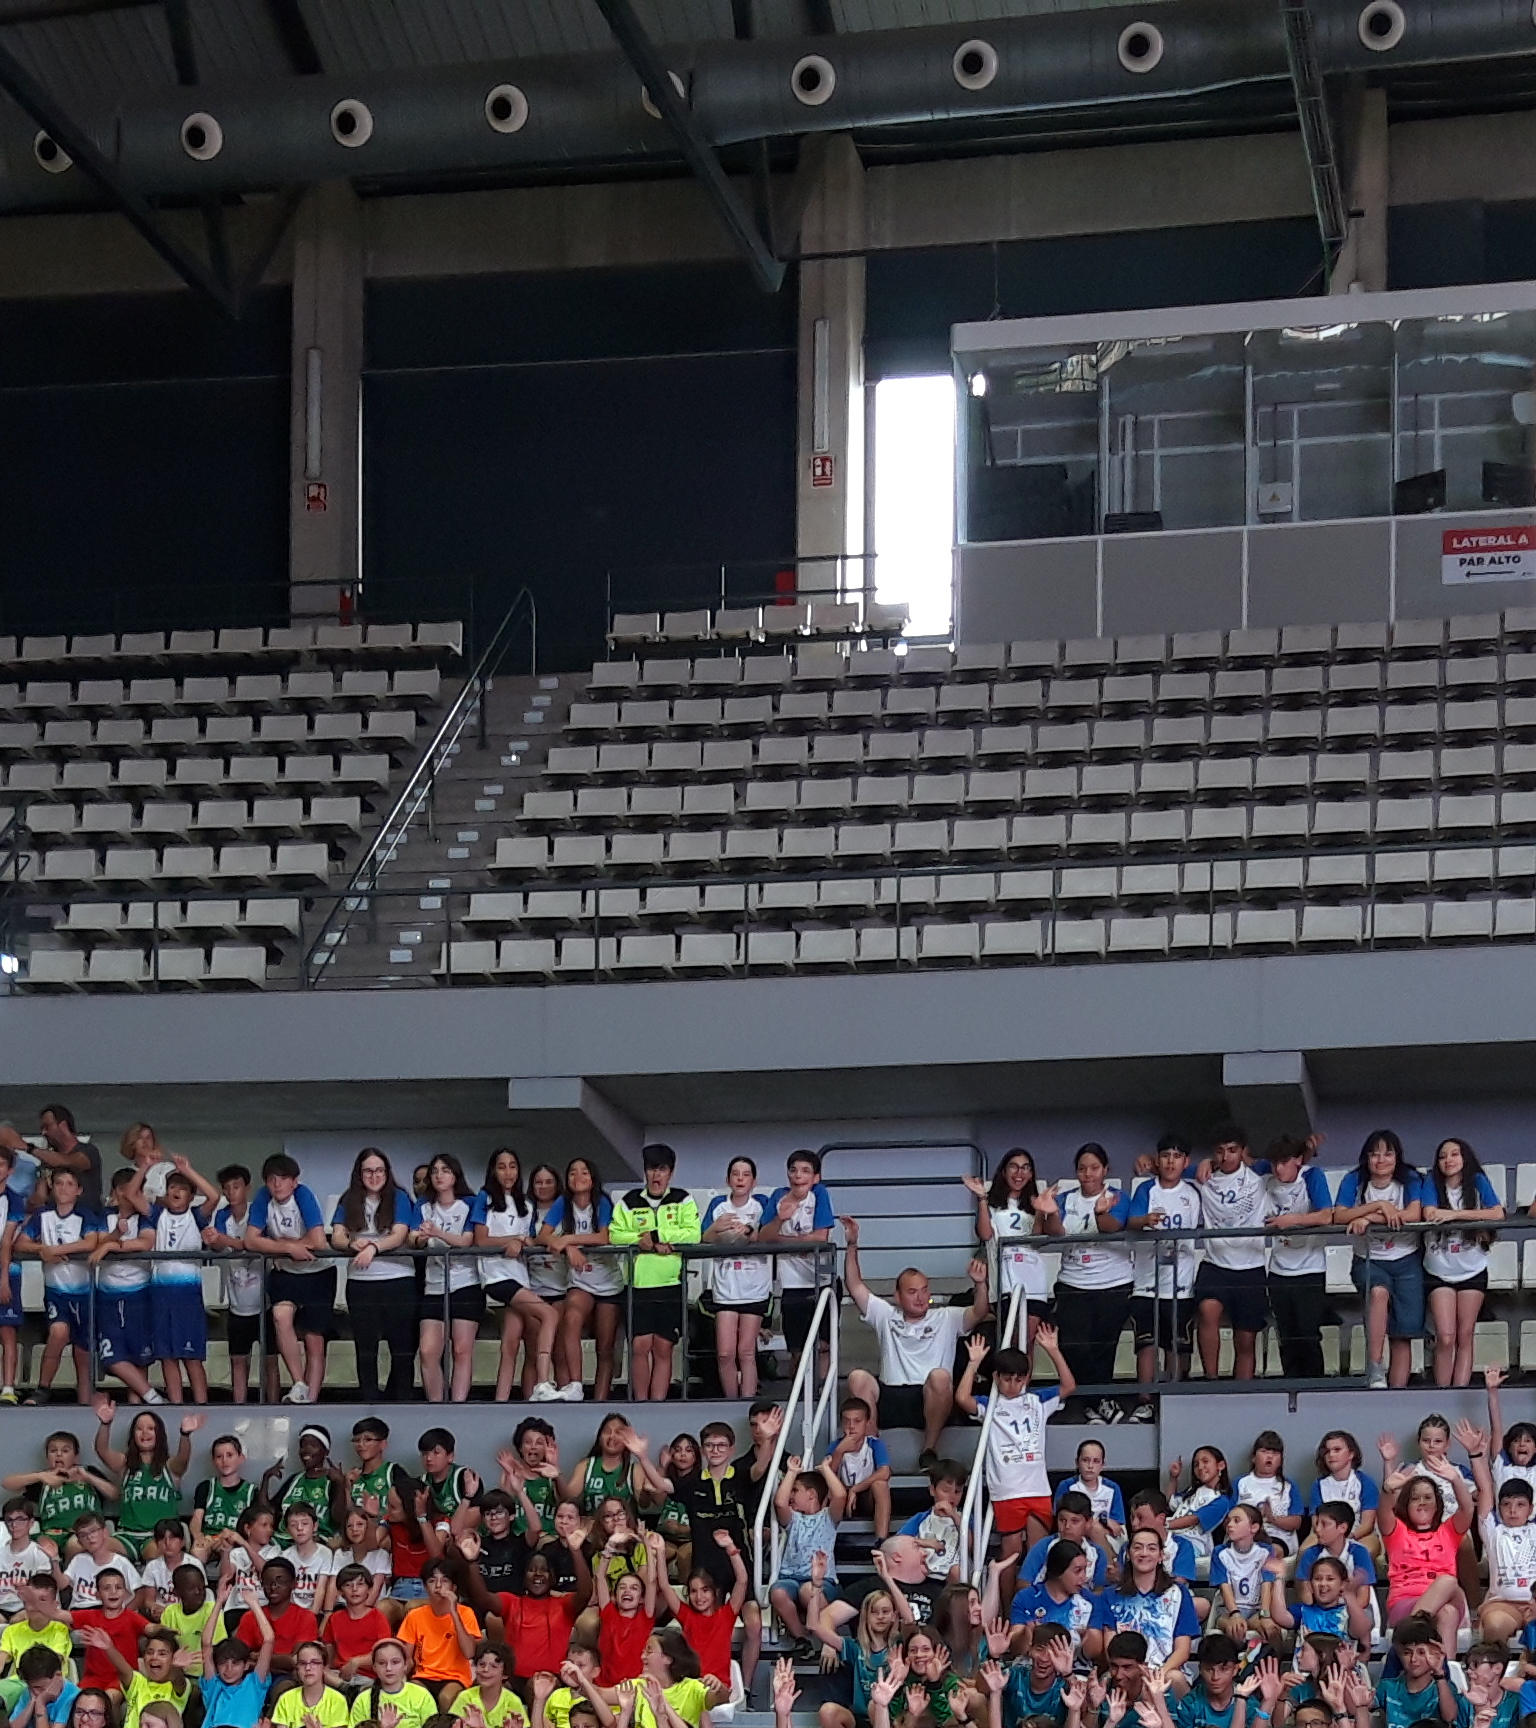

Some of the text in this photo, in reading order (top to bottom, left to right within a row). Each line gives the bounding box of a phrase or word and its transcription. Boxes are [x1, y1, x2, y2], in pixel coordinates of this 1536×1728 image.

[1452, 534, 1529, 548] LATERAL A
[1459, 555, 1521, 566] PAR ALTO
[1010, 1213, 1021, 1230] 2
[1082, 1214, 1090, 1229] 1
[1009, 1417, 1032, 1434] 11
[46, 1500, 96, 1519] GRAU
[514, 1503, 556, 1519] GAU
[1239, 1577, 1250, 1595] 6
